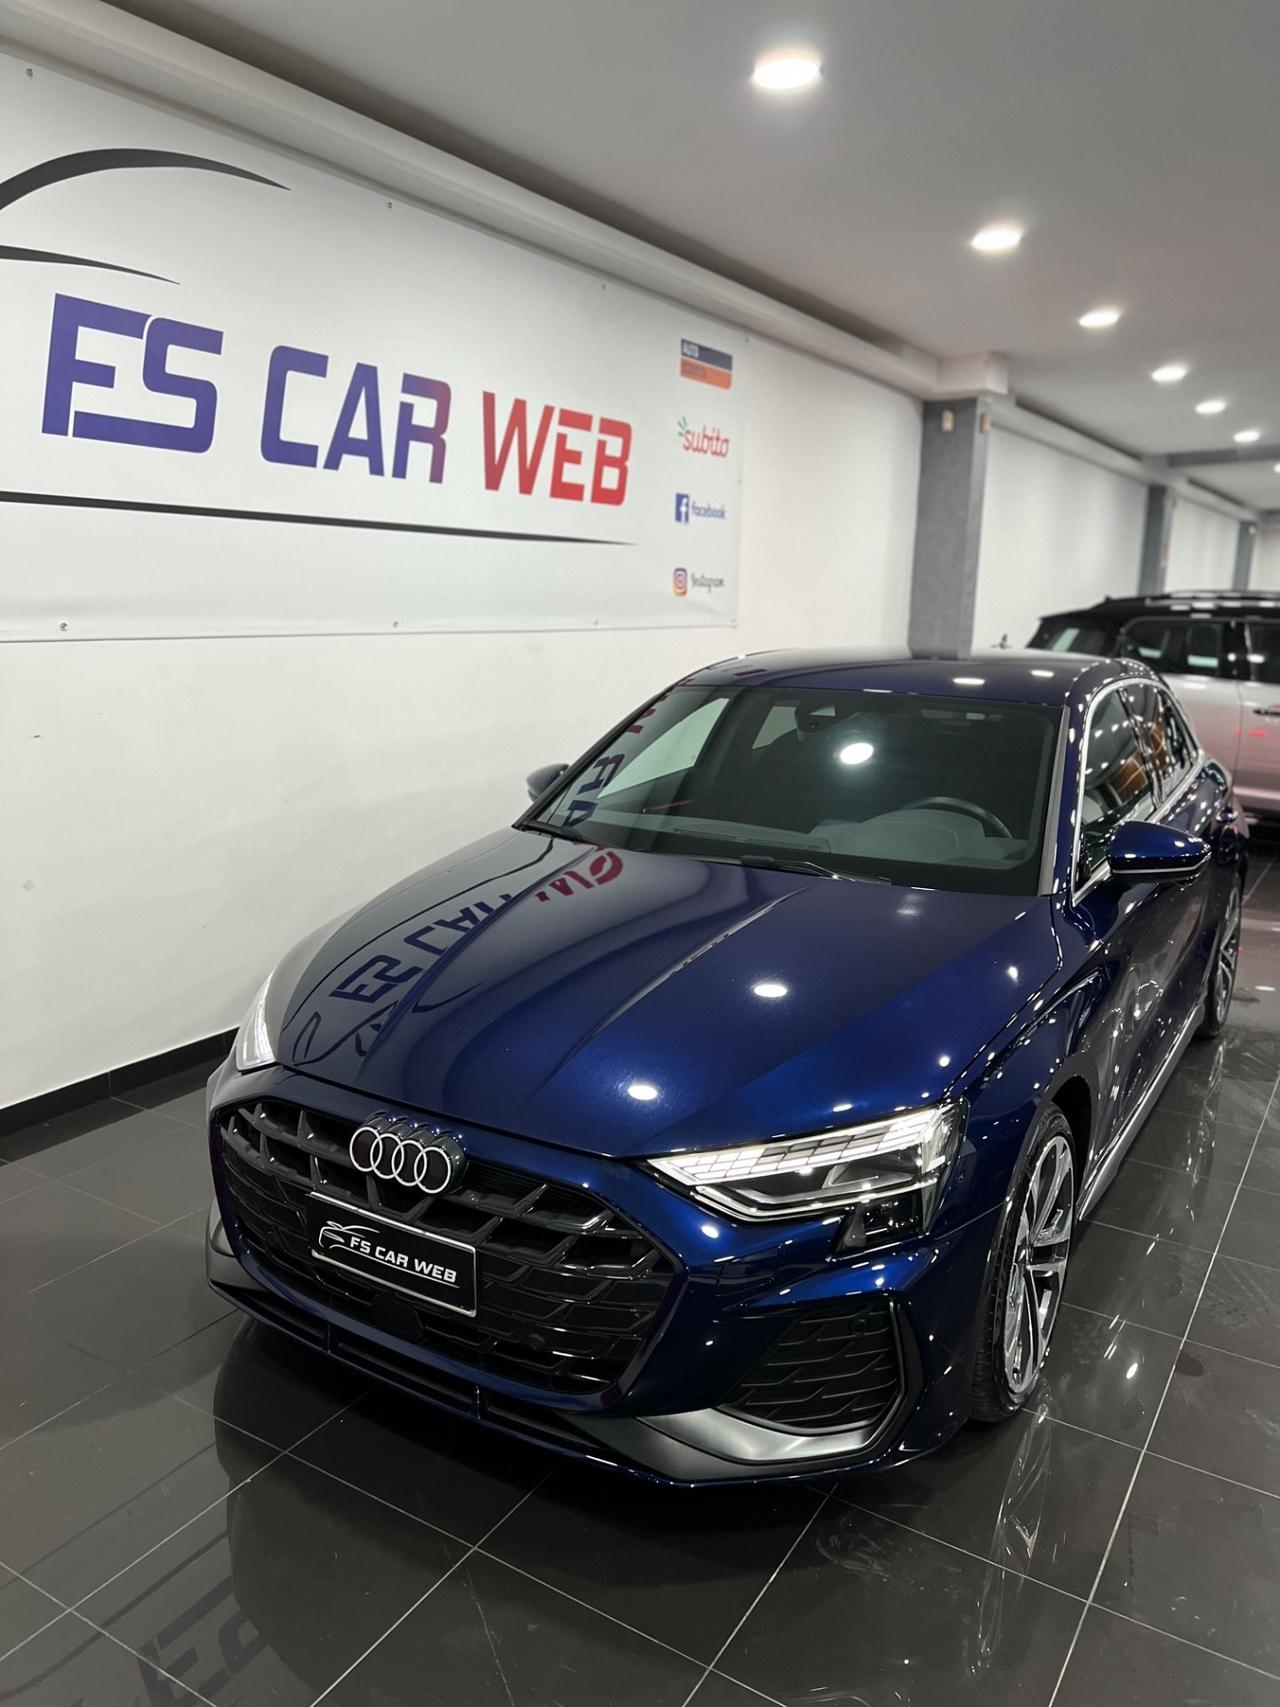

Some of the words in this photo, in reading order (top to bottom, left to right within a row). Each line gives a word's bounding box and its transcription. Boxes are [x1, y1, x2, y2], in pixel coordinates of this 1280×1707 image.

[41, 292, 224, 454] FS
[260, 344, 452, 485] CAR
[482, 390, 633, 507] WEB
[682, 425, 730, 458] subito
[691, 501, 727, 520] facebook
[349, 1236, 372, 1254] FS
[375, 1246, 409, 1268] CAR
[414, 1258, 457, 1283] WEB
